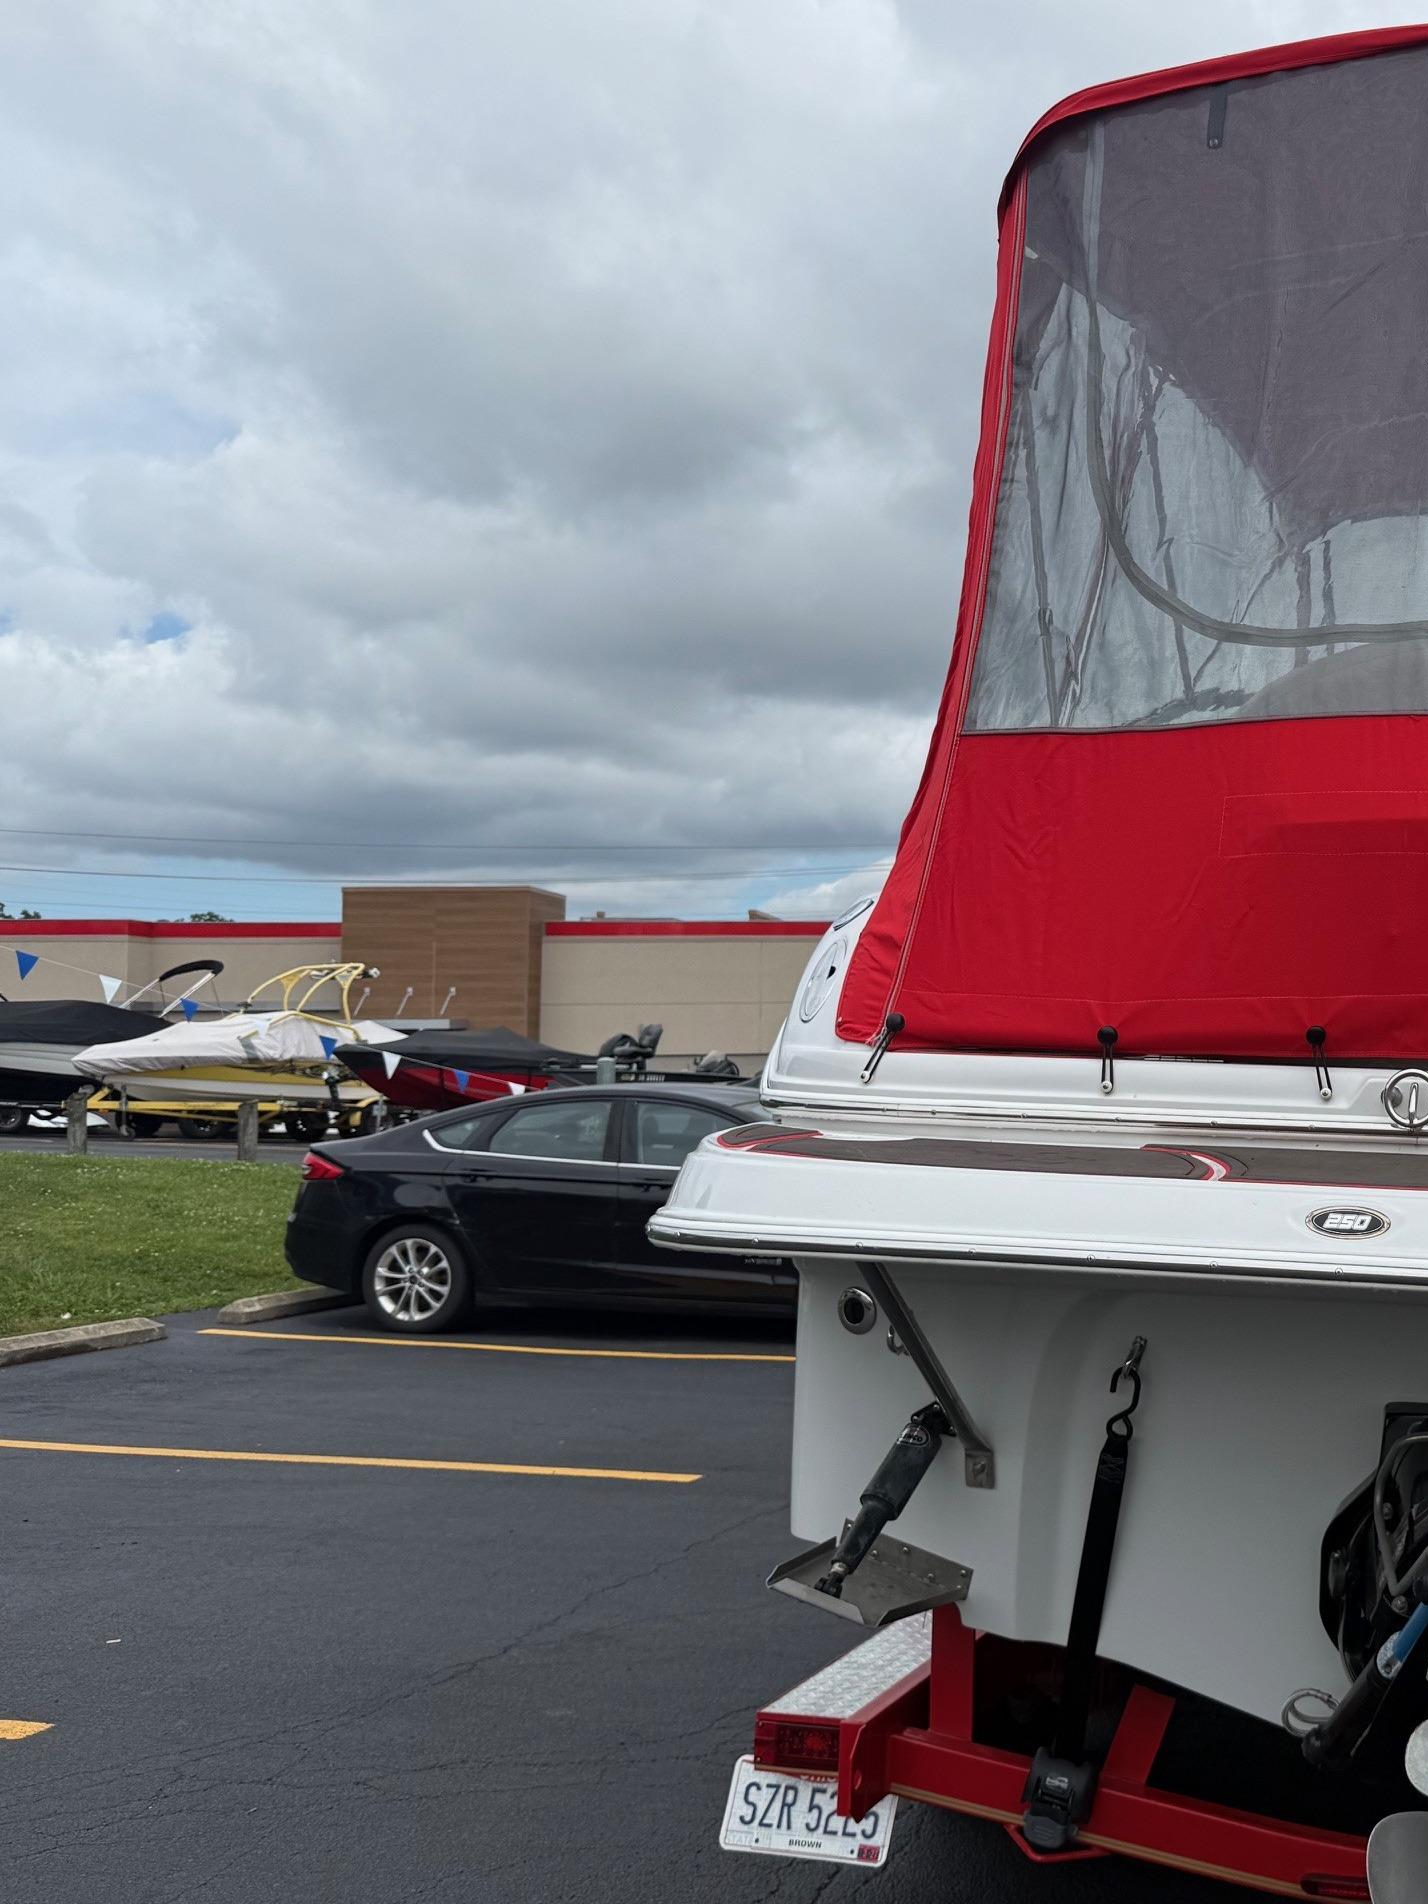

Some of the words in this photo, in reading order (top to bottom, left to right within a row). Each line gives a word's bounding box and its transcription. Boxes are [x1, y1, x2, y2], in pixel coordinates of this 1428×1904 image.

[1322, 1212, 1372, 1231] 250
[739, 1781, 799, 1831] SZR
[788, 1838, 822, 1849] BROWN
